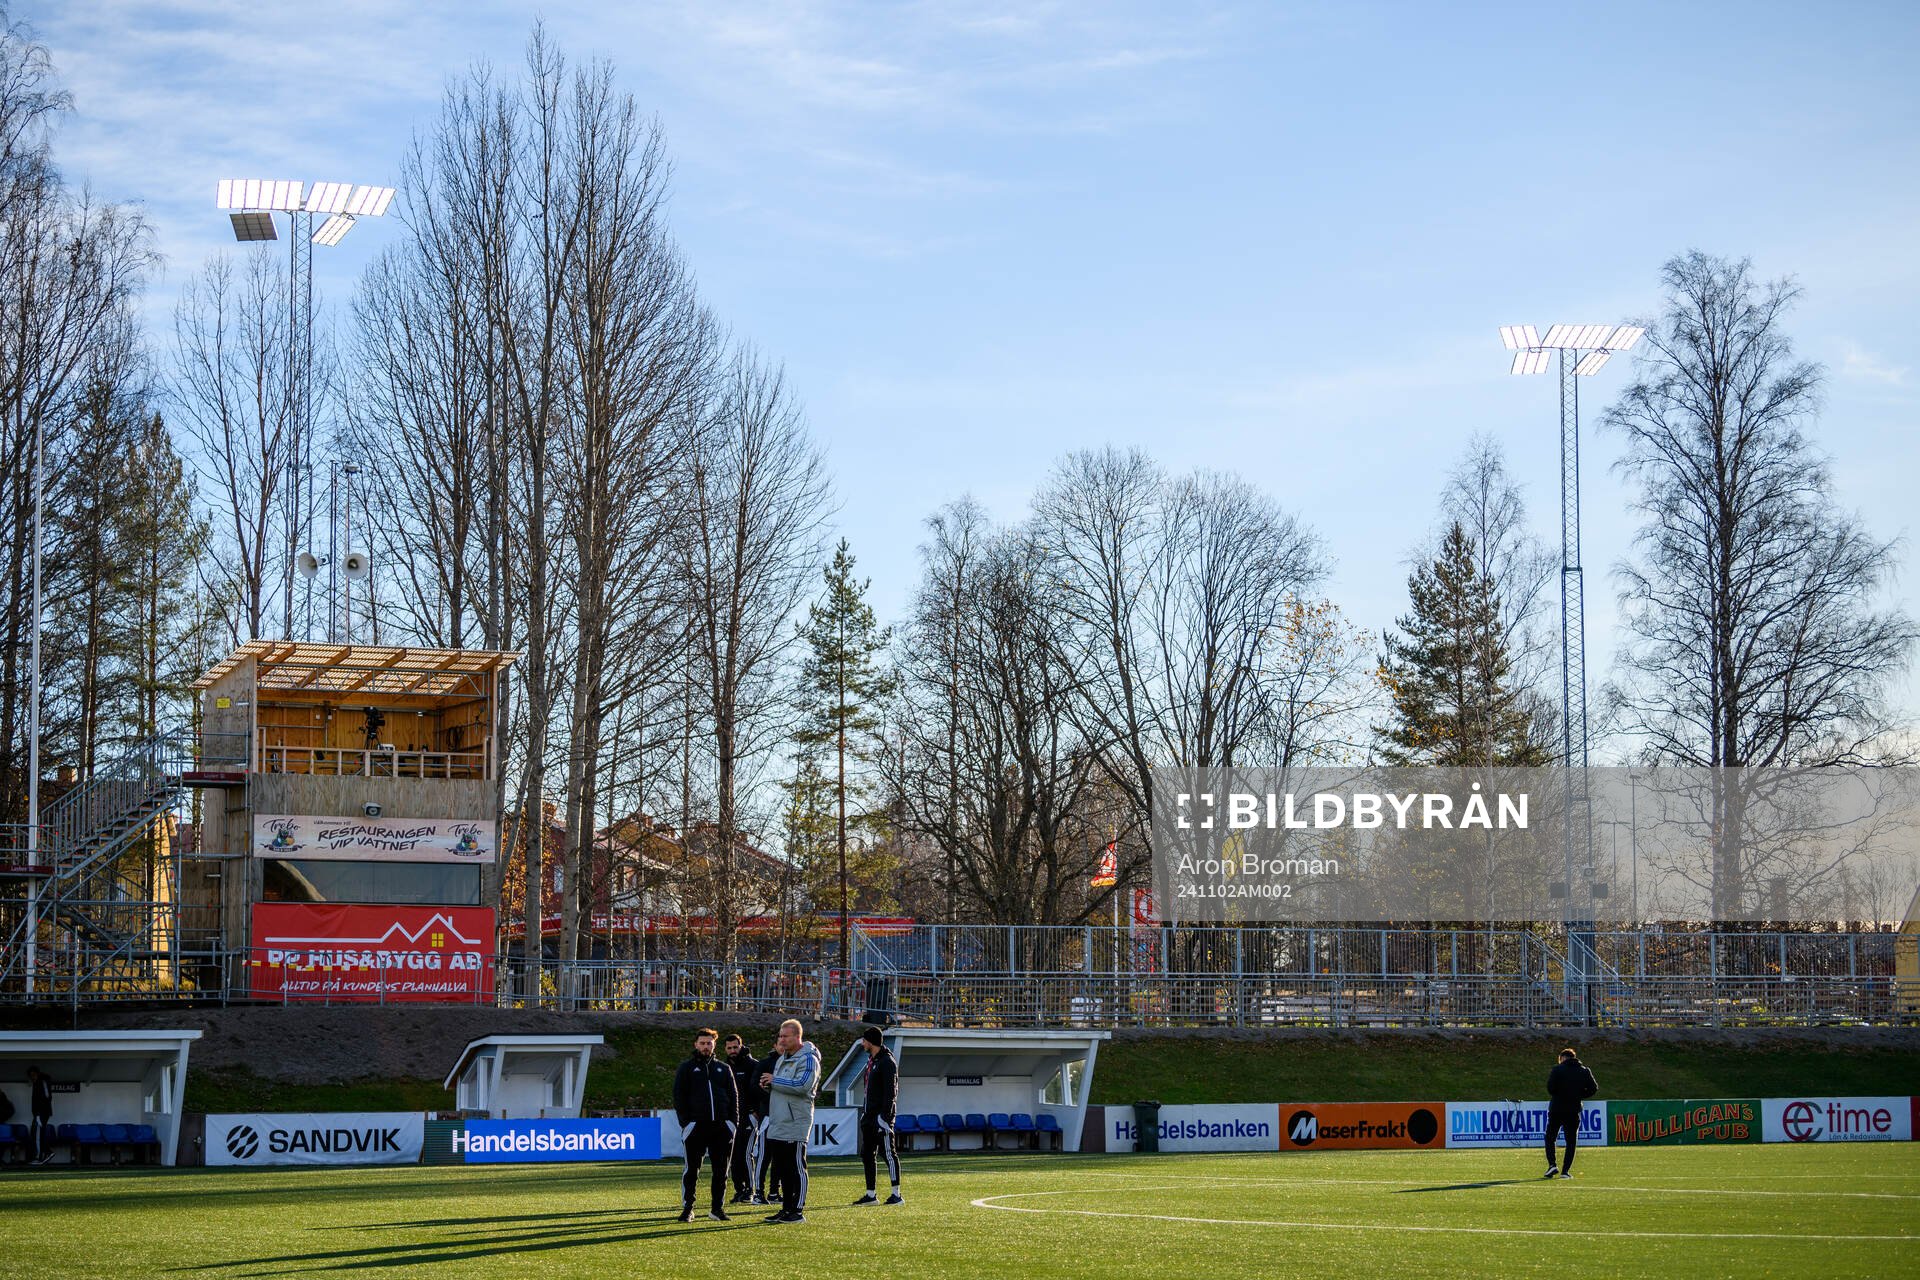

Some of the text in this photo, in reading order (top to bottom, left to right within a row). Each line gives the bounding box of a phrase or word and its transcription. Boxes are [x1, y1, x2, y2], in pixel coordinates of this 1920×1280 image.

[262, 818, 301, 833] Trebo
[447, 823, 484, 836] Trebo
[317, 826, 437, 842] RESTAURANGEN
[330, 837, 421, 851] VID VATTNET
[449, 951, 482, 970] AB
[279, 977, 468, 992] ALLTID PÅ KUNDENS PLANHALVA
[1115, 1119, 1270, 1140] Hadelsbanken
[1697, 1123, 1750, 1140] PUB
[268, 1128, 402, 1154] SANDVIK
[452, 1128, 636, 1153] Handelsbanken
